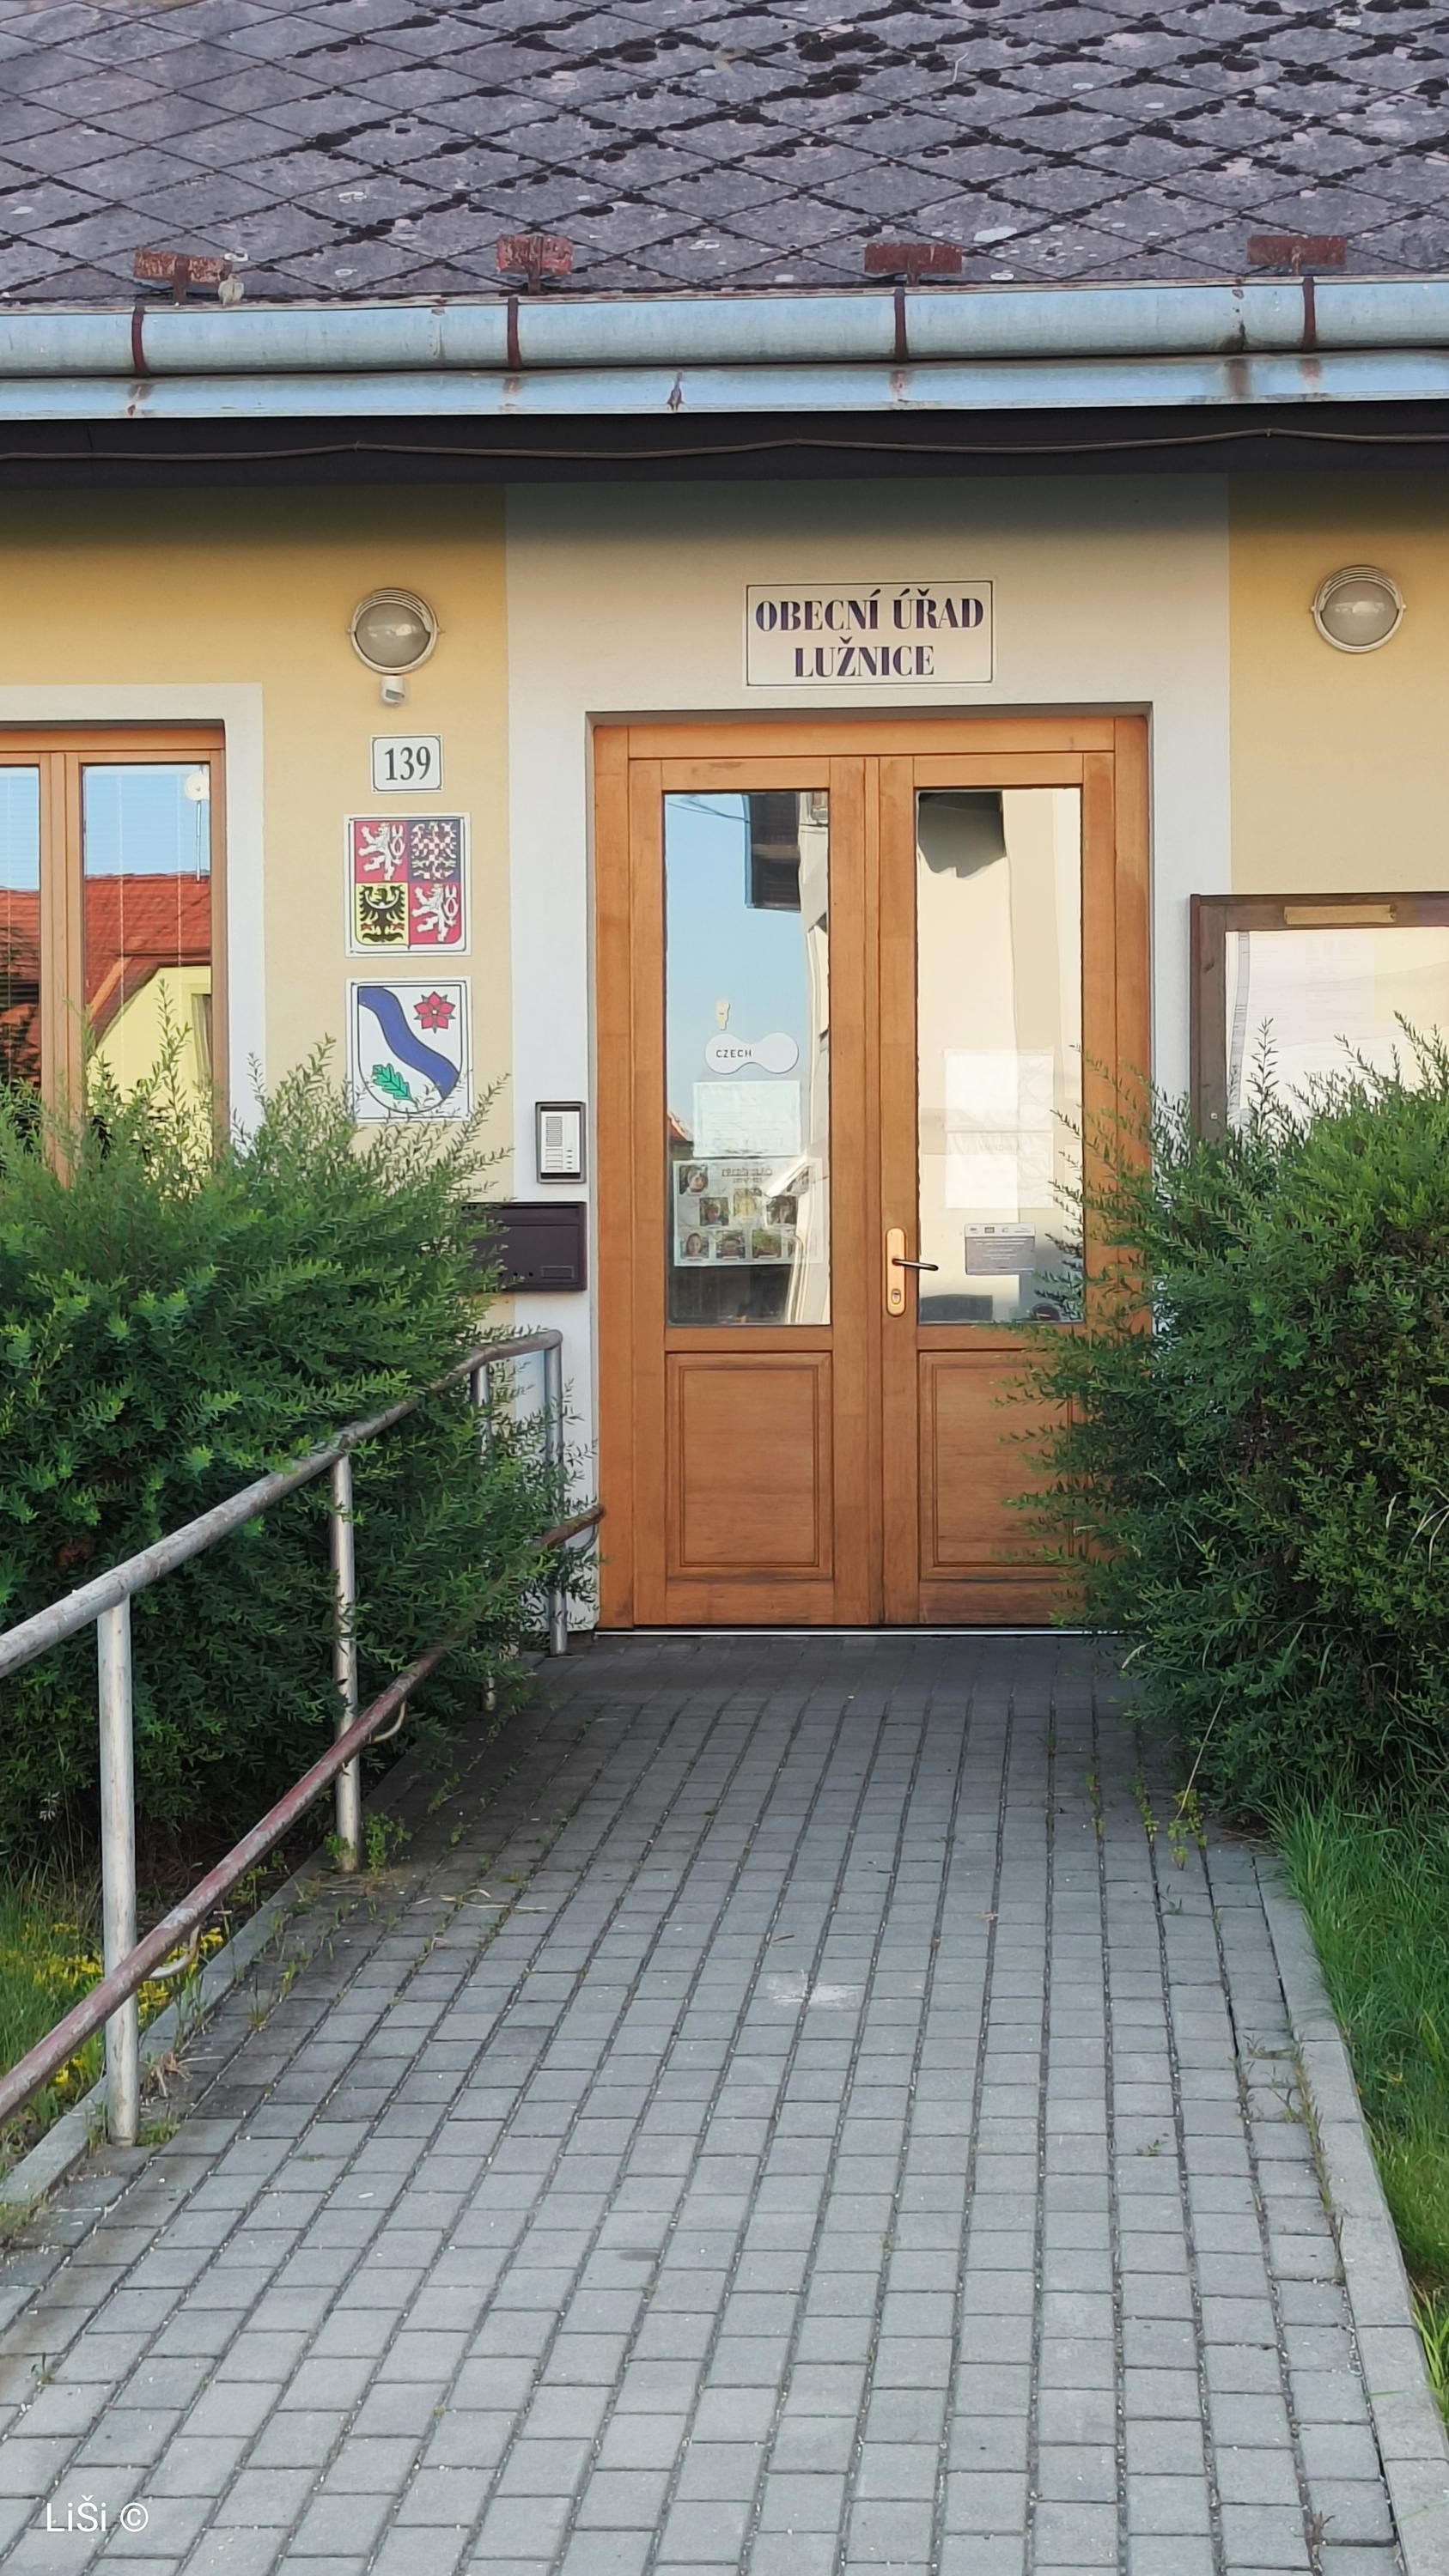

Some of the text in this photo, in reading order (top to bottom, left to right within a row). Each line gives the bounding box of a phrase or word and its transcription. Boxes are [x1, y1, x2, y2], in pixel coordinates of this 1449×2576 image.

[756, 588, 983, 631] OBECNÍ ÚŘAD
[795, 636, 935, 677] LUŽNICE
[384, 745, 431, 781] 139
[715, 1049, 752, 1058] CZECH
